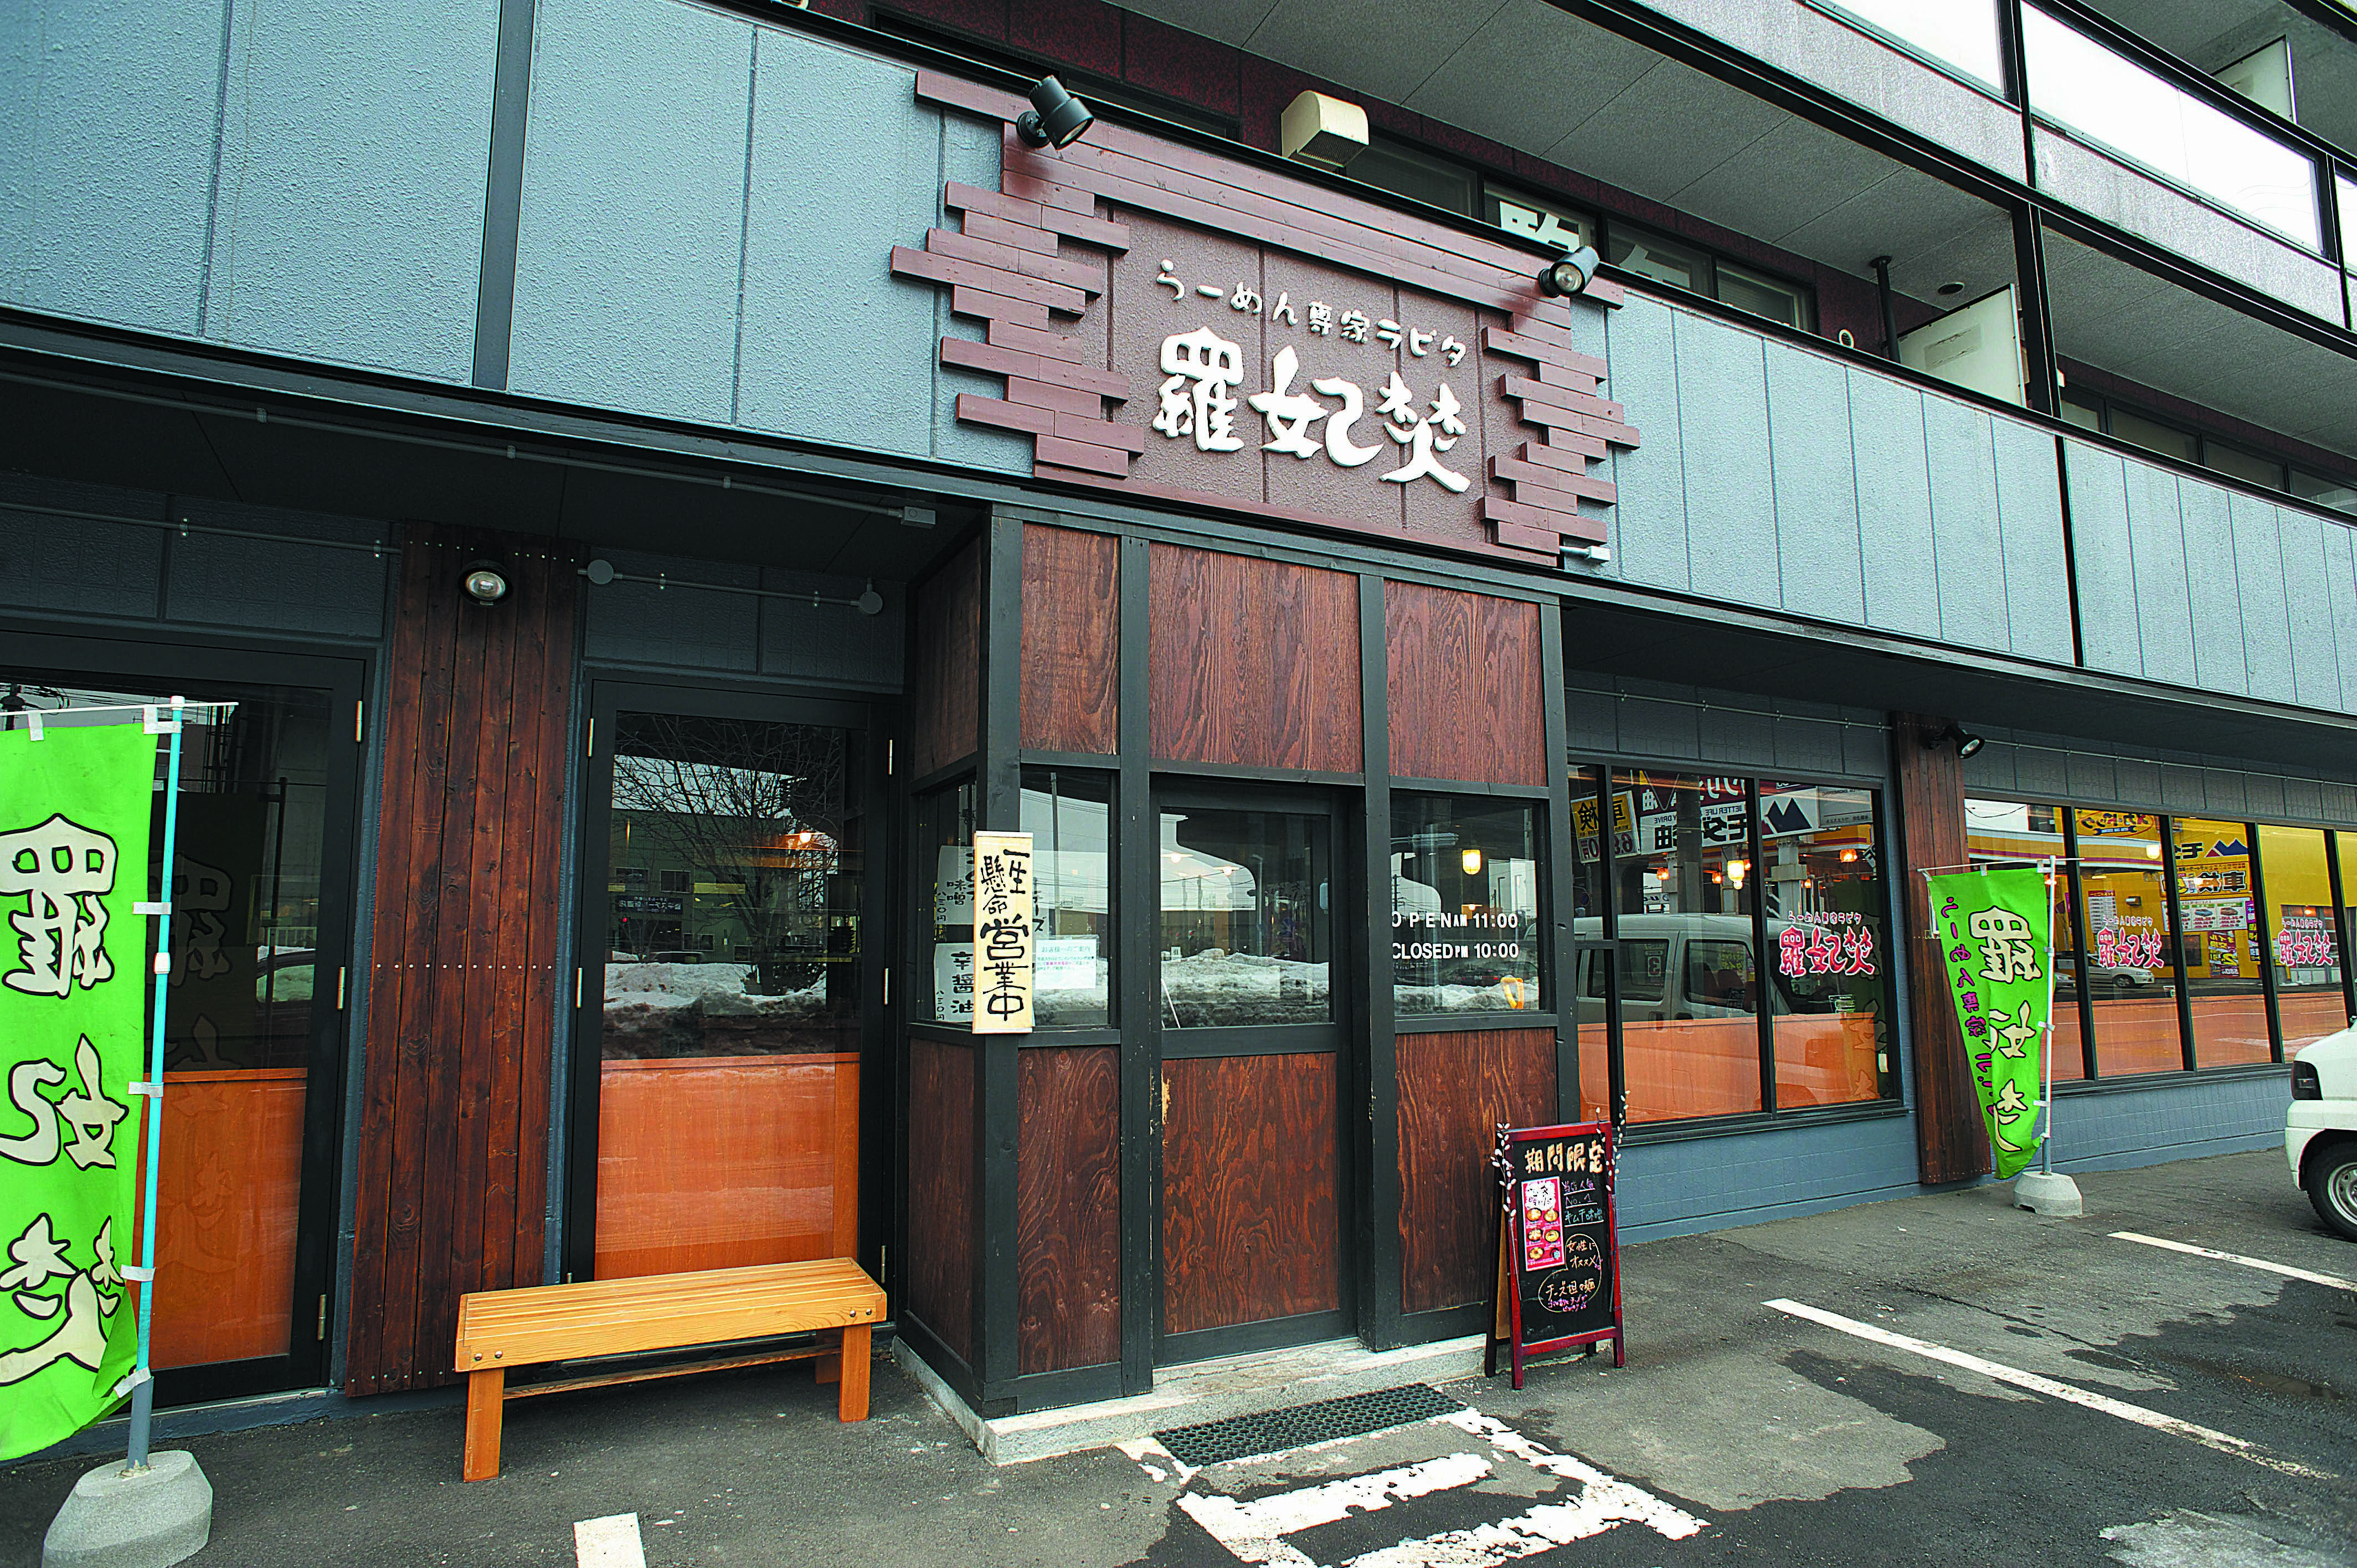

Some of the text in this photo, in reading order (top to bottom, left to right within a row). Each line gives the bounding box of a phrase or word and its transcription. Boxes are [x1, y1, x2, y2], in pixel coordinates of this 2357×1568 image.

[1391, 911, 1519, 929] OPEN AM 11:00
[1392, 943, 1519, 960] CLOSED PM 10:00
[980, 914, 1030, 1022] 営業中
[1525, 1139, 1605, 1174] 期間限定
[1567, 1239, 1596, 1253] 女性に
